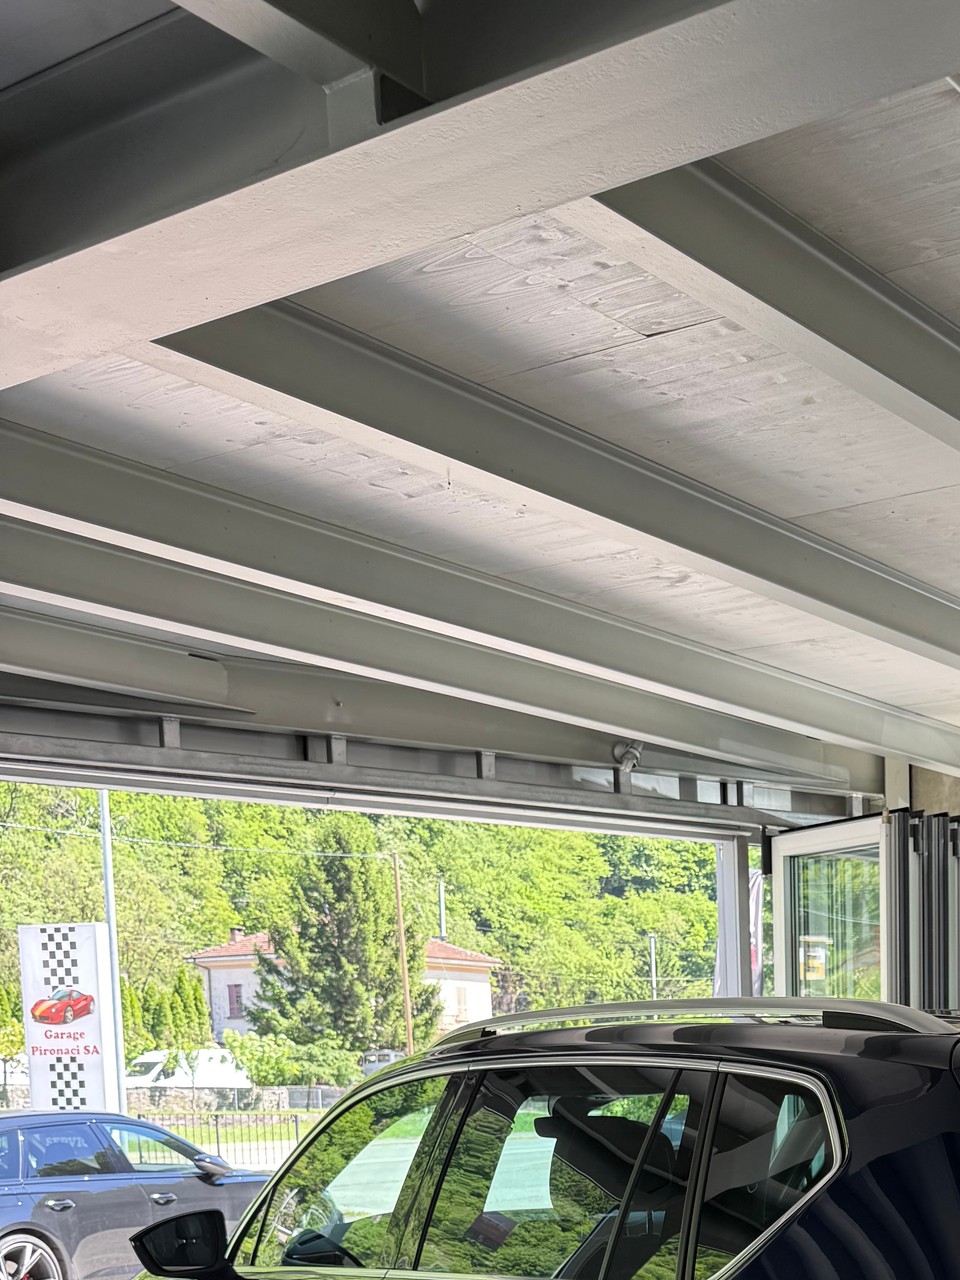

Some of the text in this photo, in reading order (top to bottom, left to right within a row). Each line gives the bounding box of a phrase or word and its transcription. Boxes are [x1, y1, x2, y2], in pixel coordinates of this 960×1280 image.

[44, 1029, 86, 1041] Garage
[31, 1044, 101, 1057] Pironaci SA
